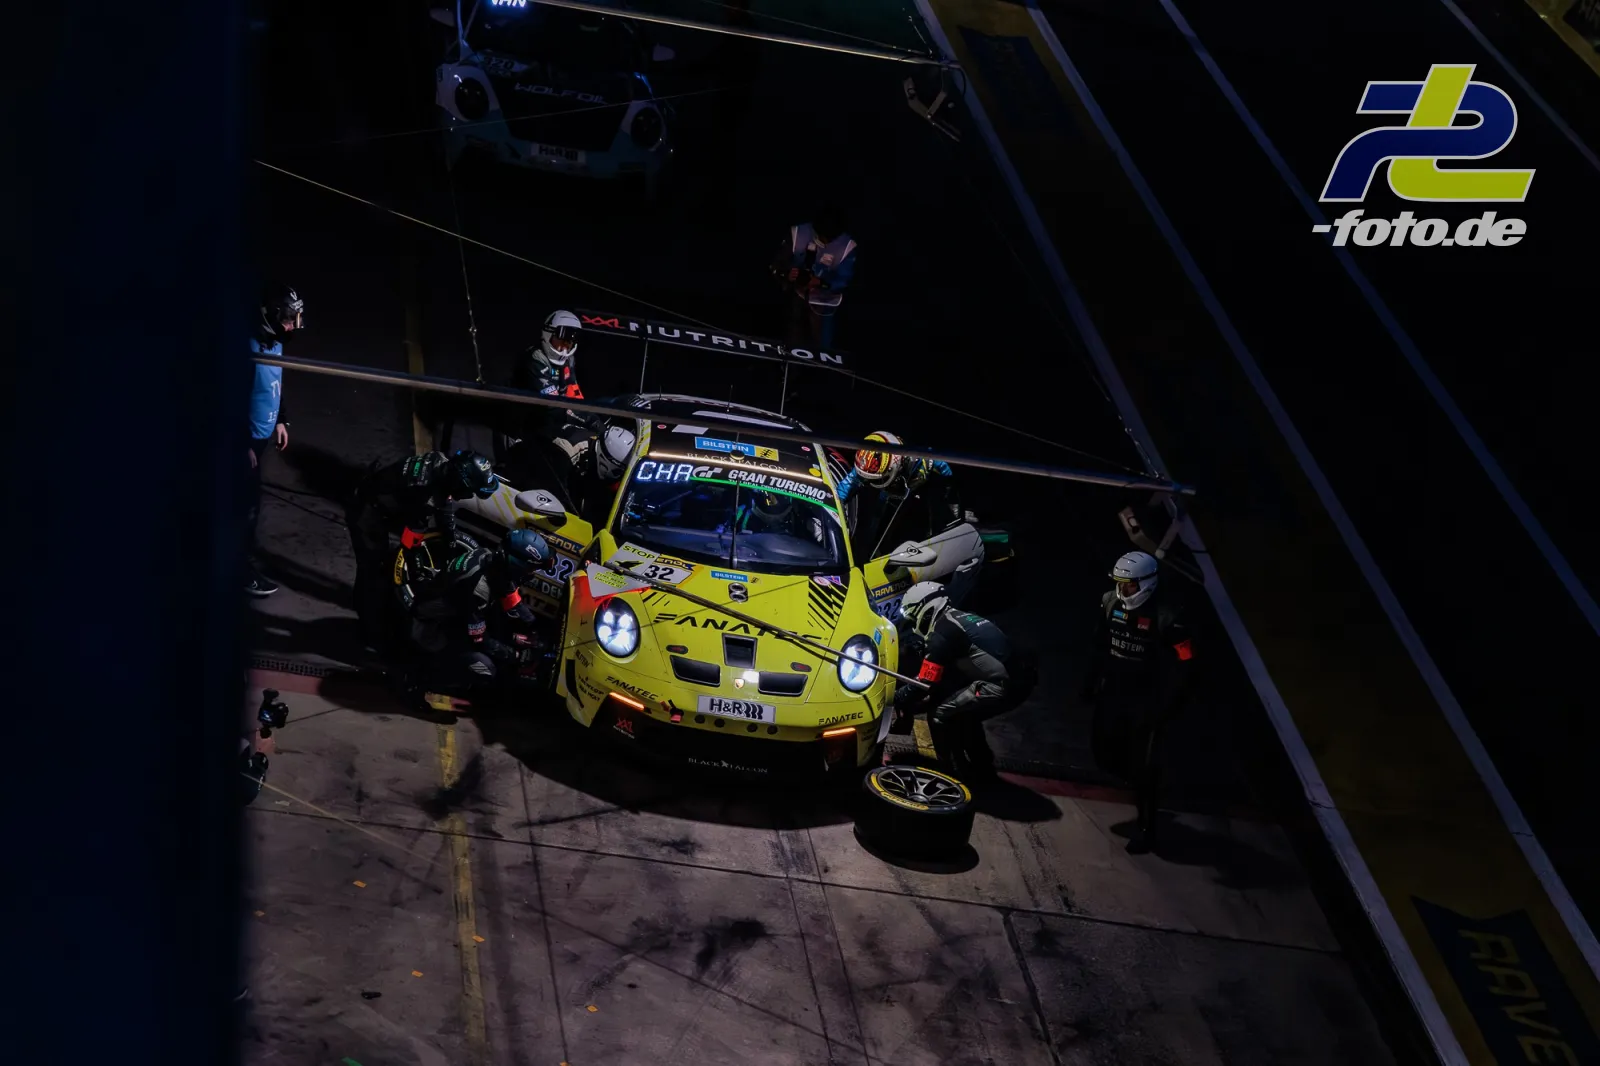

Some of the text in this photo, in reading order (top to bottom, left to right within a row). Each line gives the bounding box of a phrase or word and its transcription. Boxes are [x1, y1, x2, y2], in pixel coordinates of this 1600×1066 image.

[581, 313, 626, 329] XXL
[702, 439, 750, 453] BILSTEIN
[636, 461, 693, 481] CHA
[727, 469, 767, 484] GRAN
[622, 545, 655, 559] STOP
[644, 564, 675, 582] 32
[714, 571, 745, 581] BILSTEIN
[1111, 637, 1145, 652] BILSTEIN
[605, 675, 659, 701] FANATEC
[818, 711, 864, 726] FANATEC
